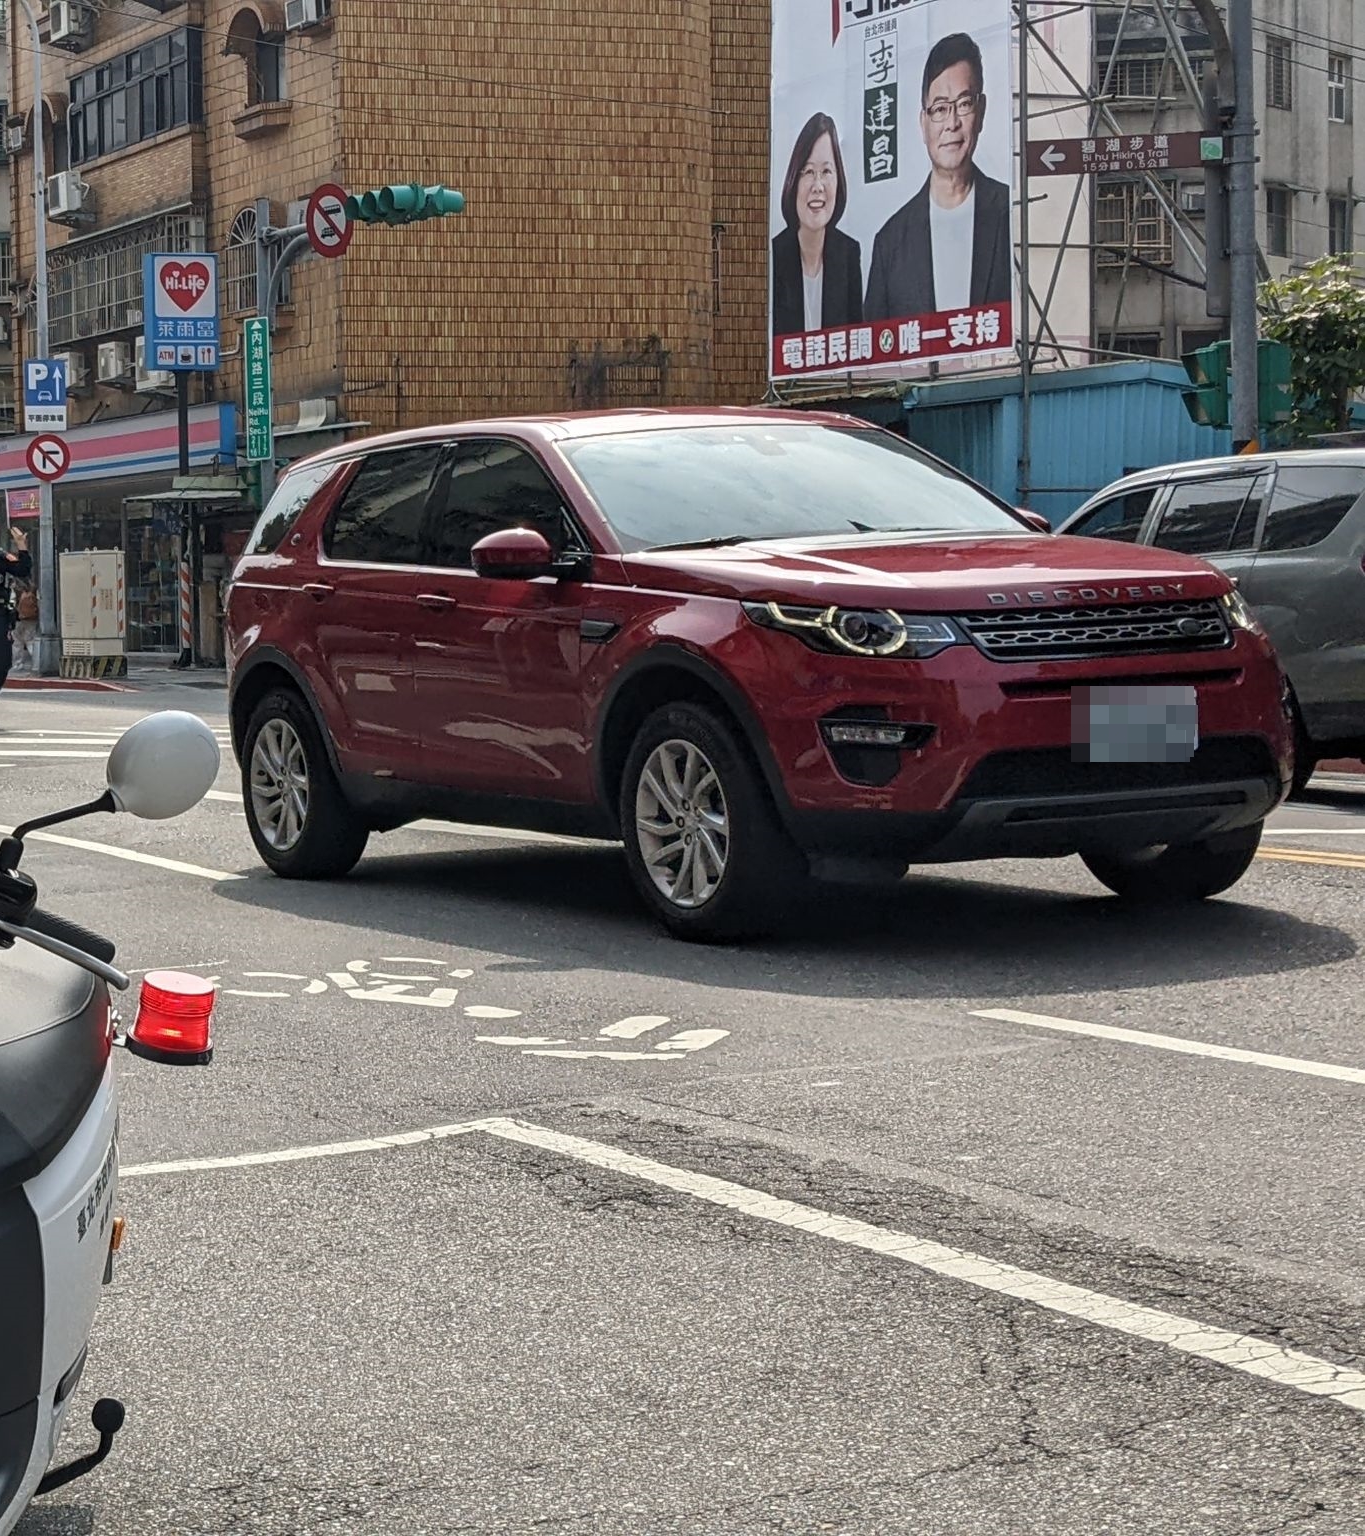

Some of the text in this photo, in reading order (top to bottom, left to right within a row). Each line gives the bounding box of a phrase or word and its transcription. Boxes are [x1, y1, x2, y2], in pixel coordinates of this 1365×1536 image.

[864, 18, 898, 38] 台北市議員
[865, 40, 895, 180] 李建昌
[1081, 135, 1169, 153] 碧湖步道
[1082, 149, 1169, 162] Bi hu Hiking Trail
[1083, 158, 1169, 172] 15分鐘 0.5公里
[781, 327, 872, 369] 電話民調
[898, 309, 1001, 355] 唯一支持
[158, 351, 174, 361] ATM
[28, 363, 48, 390] P
[251, 331, 264, 405] 內湖路三段
[987, 583, 1184, 605] DISCOVERY
